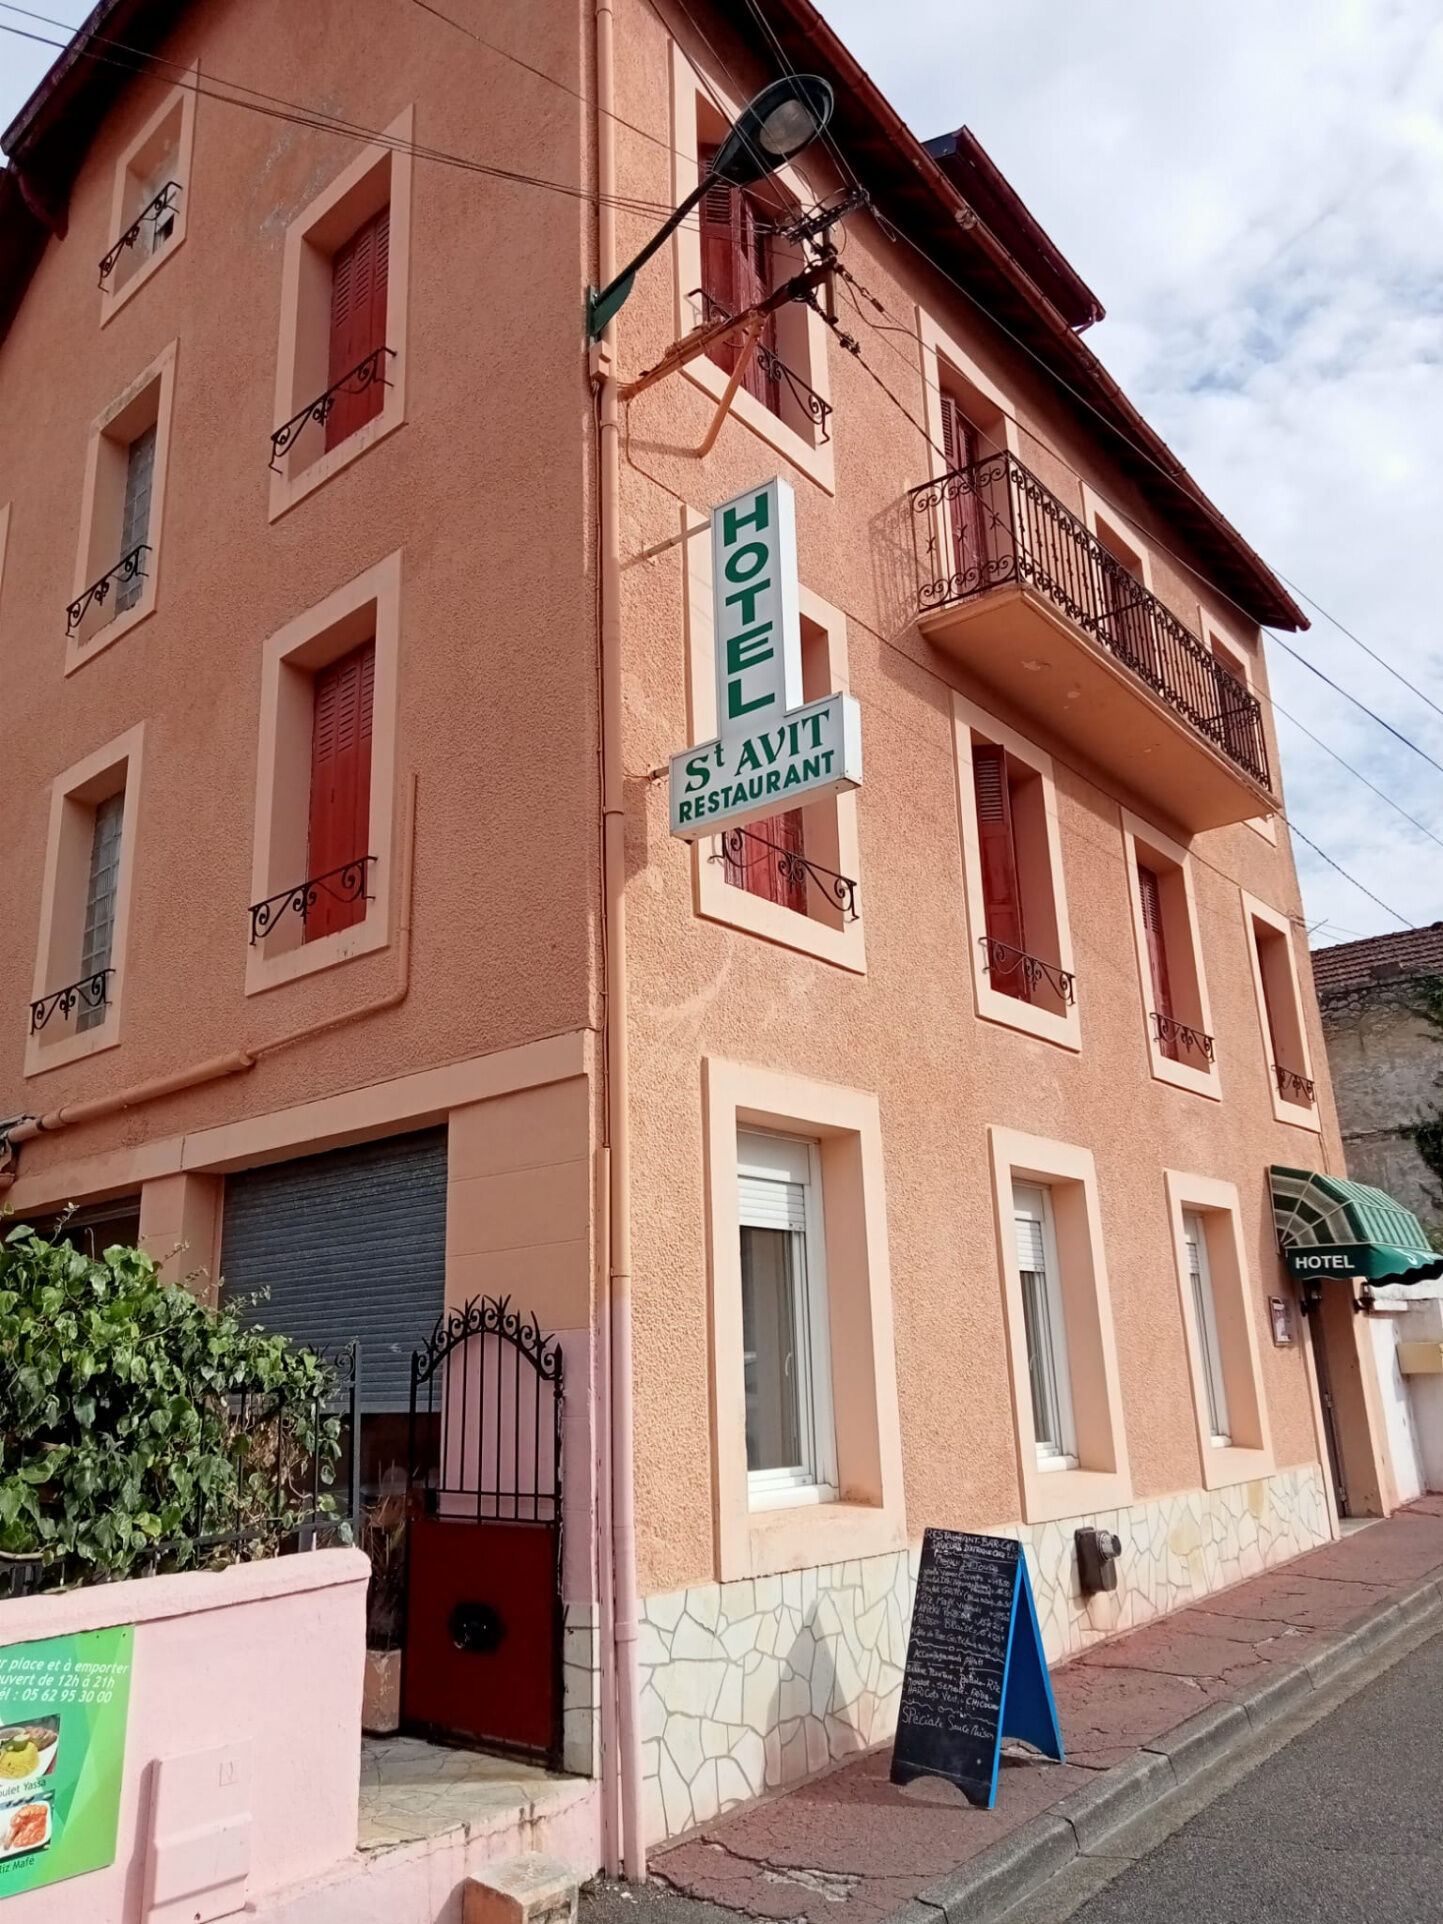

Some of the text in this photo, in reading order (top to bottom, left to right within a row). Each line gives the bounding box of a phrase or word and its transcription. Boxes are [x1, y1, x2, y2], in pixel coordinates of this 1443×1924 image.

[723, 491, 775, 720] HOTEL
[734, 708, 830, 777] AVIT
[678, 749, 835, 823] RESTAURANT
[1295, 1254, 1355, 1269] HOTEL
[8, 1657, 45, 1672] place
[47, 1660, 61, 1671] et
[74, 1661, 128, 1677] emporter
[38, 1673, 54, 1686] de
[58, 1675, 80, 1688] 12h
[93, 1676, 115, 1689] 21h
[22, 1688, 39, 1701] 05
[41, 1689, 58, 1702] 62
[60, 1689, 77, 1702] 95
[78, 1690, 95, 1703] 30
[97, 1690, 113, 1703] 00
